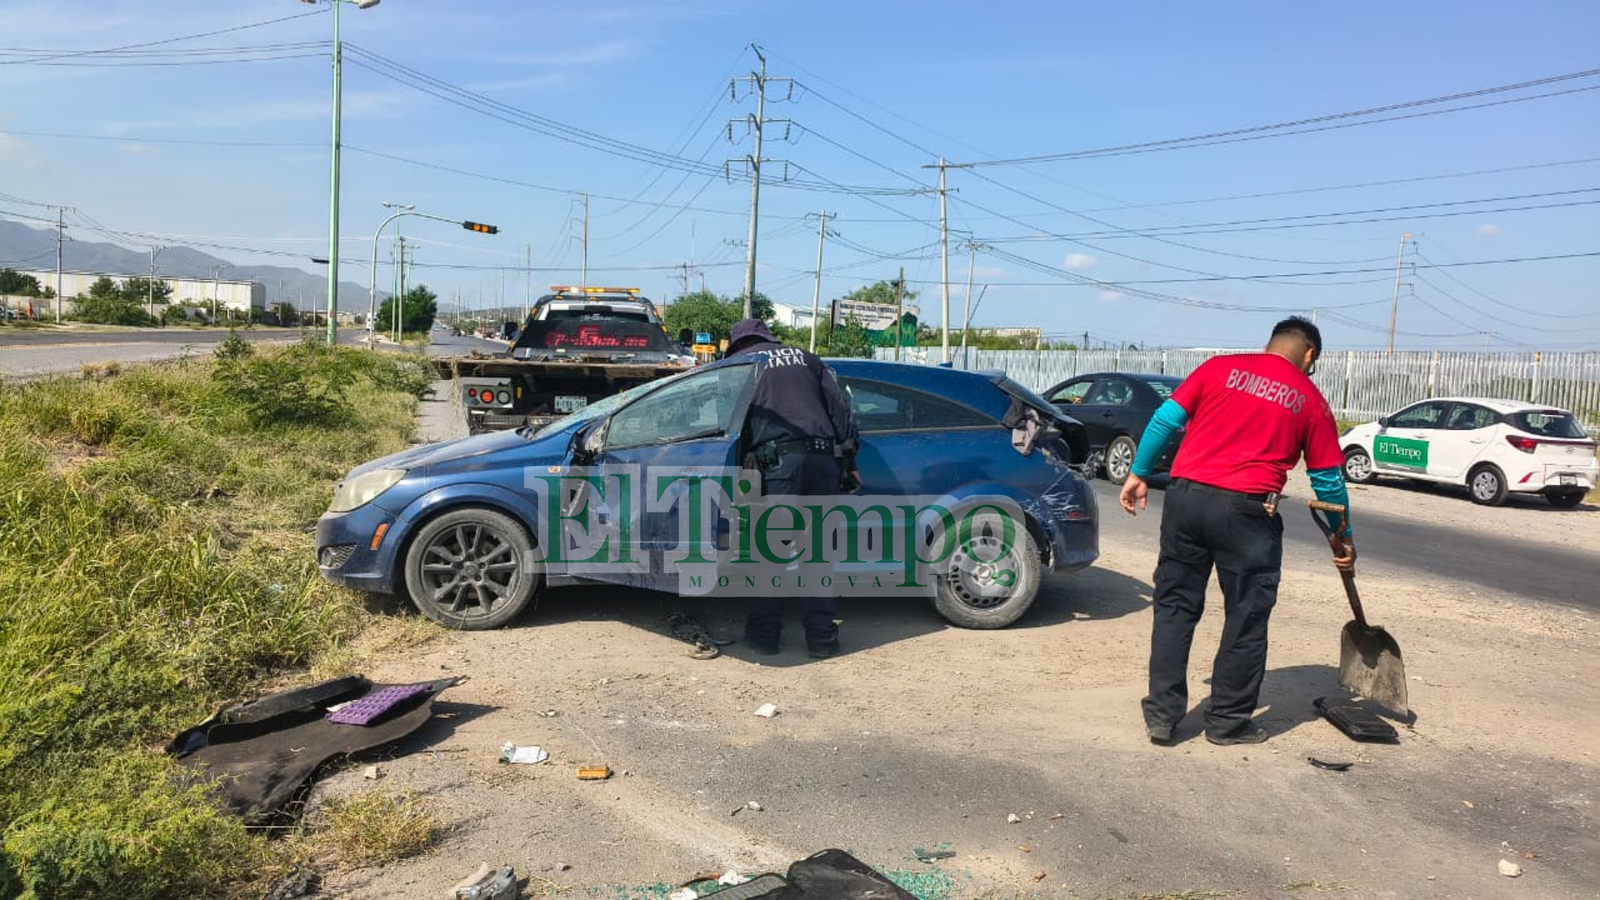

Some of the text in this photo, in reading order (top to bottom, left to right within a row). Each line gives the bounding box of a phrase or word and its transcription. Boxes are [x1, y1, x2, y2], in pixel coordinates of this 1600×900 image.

[765, 355, 807, 368] TATAL
[1226, 368, 1305, 414] BOMBEROS
[1379, 442, 1421, 460] El Tiempo
